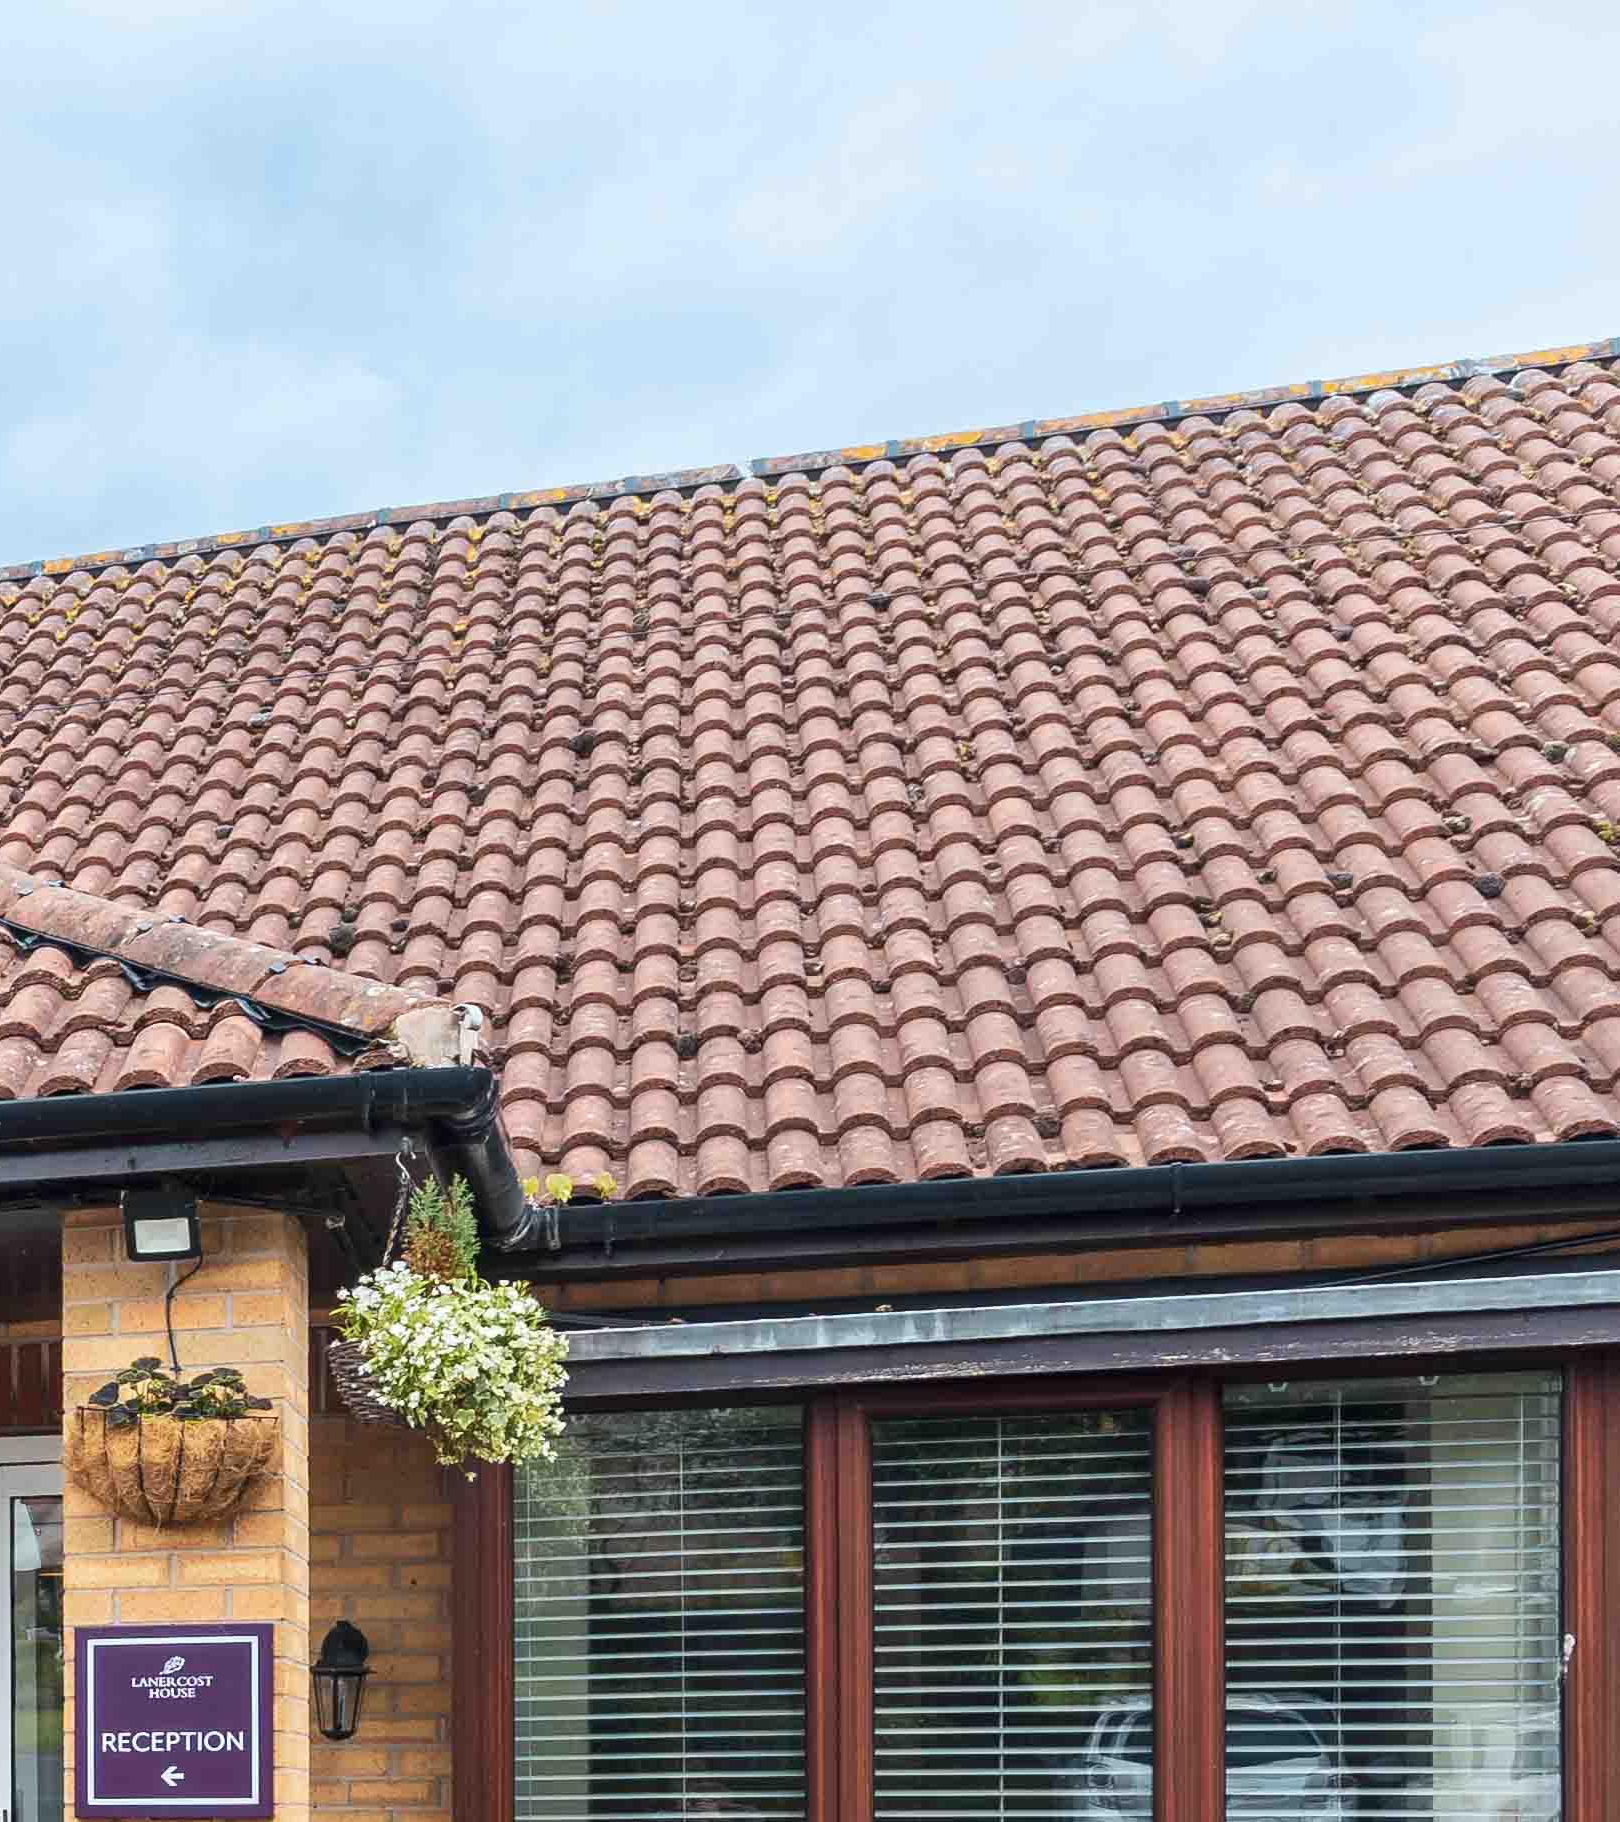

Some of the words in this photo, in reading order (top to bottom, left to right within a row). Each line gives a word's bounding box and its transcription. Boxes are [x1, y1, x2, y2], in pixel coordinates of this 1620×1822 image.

[131, 1675, 213, 1688] LANERCOST
[149, 1688, 196, 1699] HOUSE
[101, 1731, 244, 1753] RECEPTION
